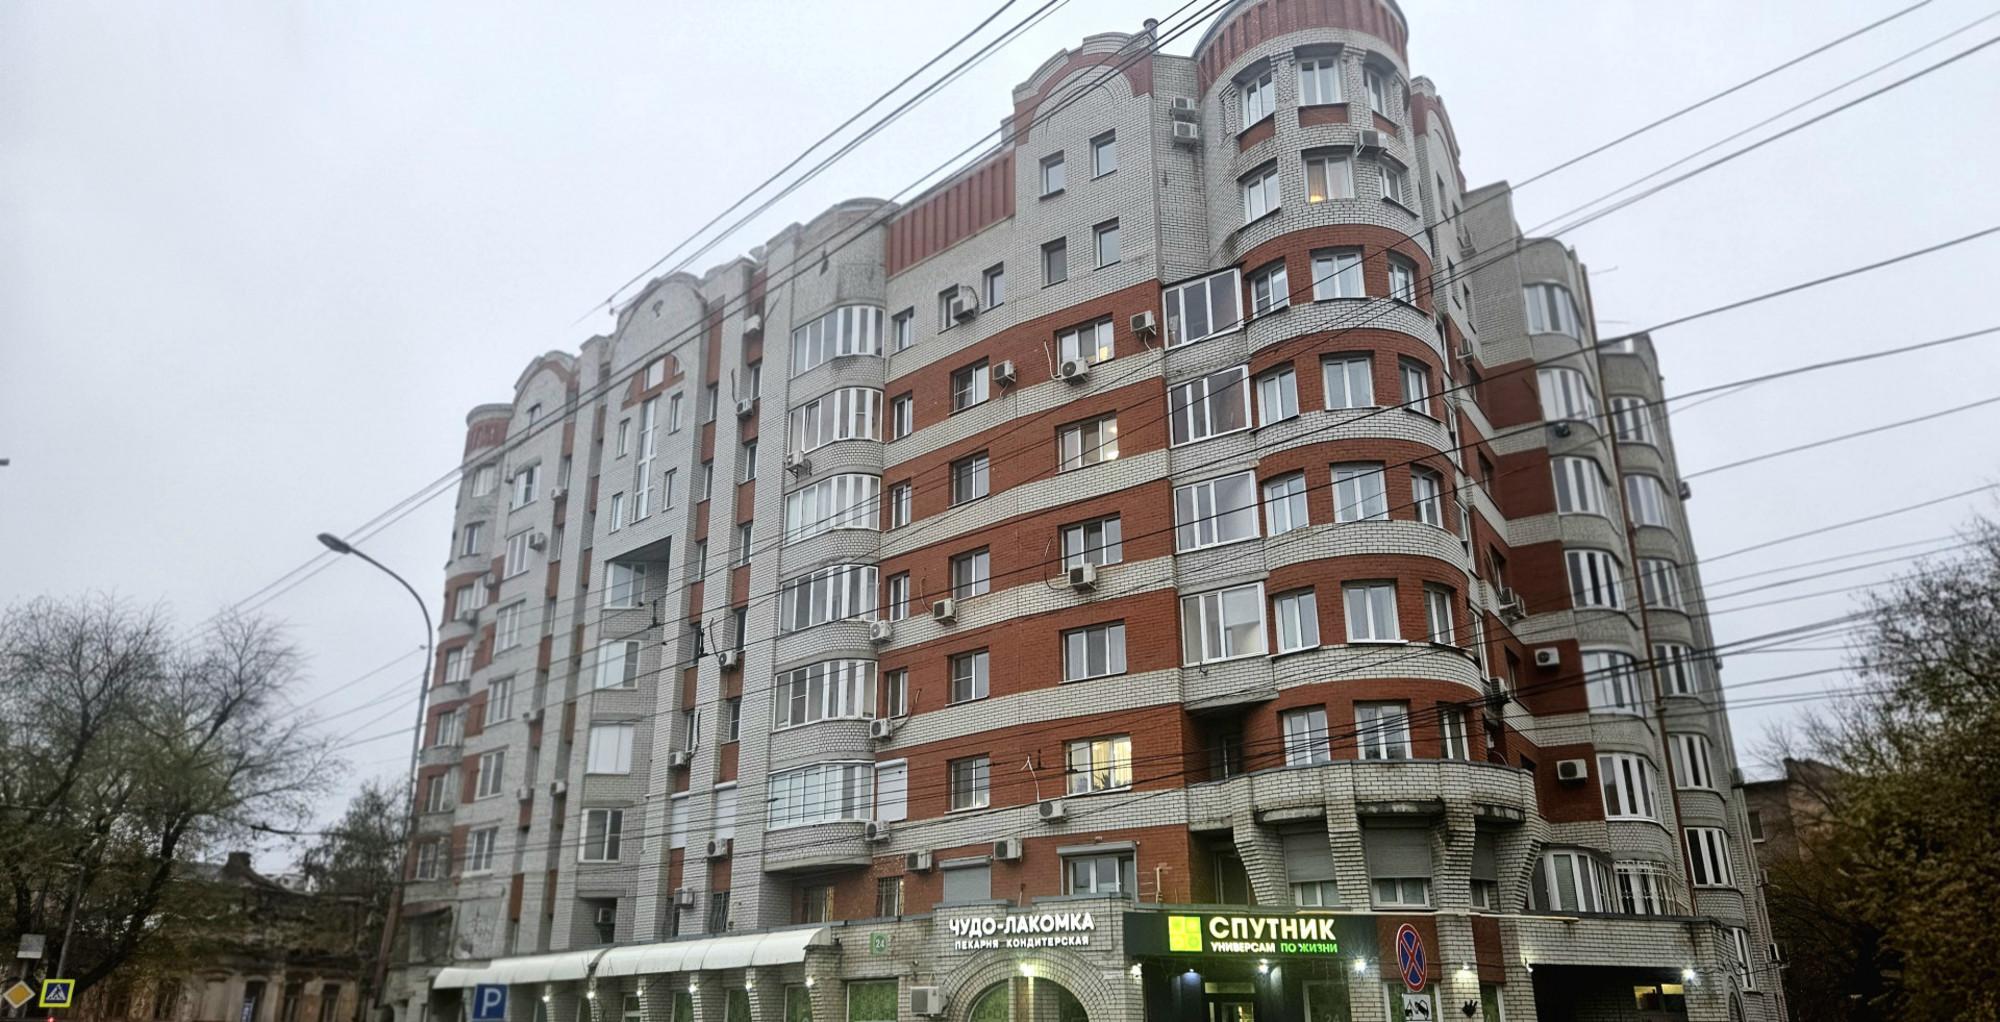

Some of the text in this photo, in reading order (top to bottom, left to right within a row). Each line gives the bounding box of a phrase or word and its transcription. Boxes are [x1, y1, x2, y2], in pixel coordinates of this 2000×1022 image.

[949, 912, 1095, 938] ЧУДО-ЛАКОМКА
[1209, 916, 1336, 940] СПУТНИК
[875, 938, 885, 949] 24
[955, 936, 1089, 950] ПЕКАРНЯ КОНДИТЕРСКАЯ
[1211, 942, 1338, 953] УНИВЕРСАМ ПО ЖИЗНИ
